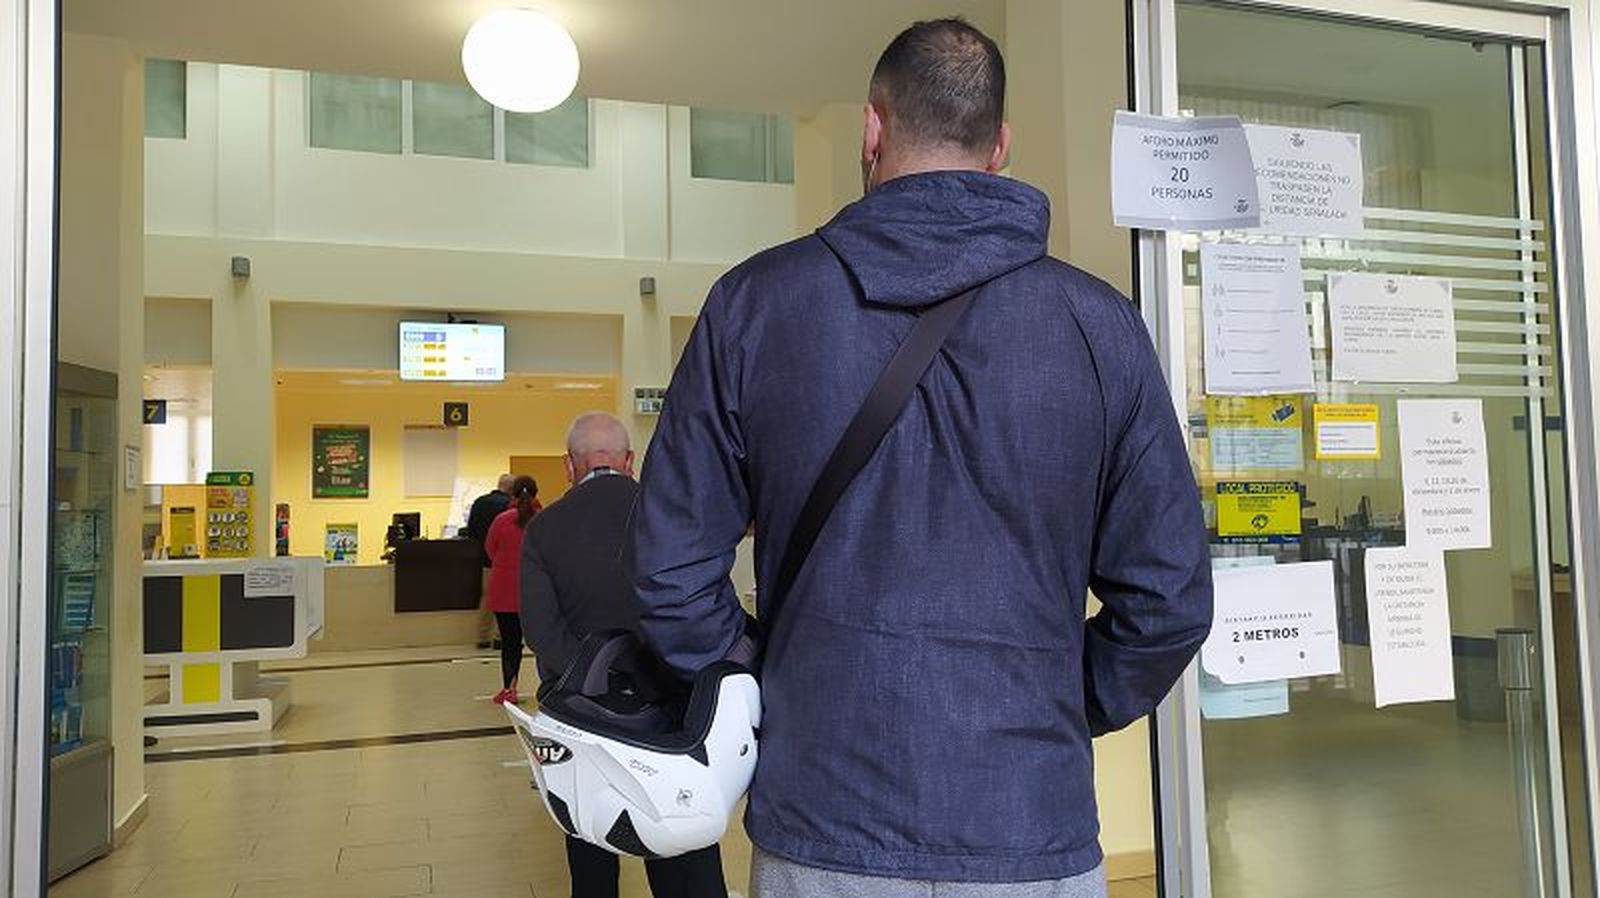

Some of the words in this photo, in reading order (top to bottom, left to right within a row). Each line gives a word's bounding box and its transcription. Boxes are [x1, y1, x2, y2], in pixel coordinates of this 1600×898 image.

[1141, 135, 1174, 147] AFORO
[1153, 149, 1209, 161] PERMITIDO
[1170, 166, 1189, 183] 20
[1151, 186, 1213, 200] PERSONAS
[146, 404, 158, 420] 7
[450, 408, 462, 422] 6
[1231, 631, 1241, 643] 2
[1243, 627, 1300, 641] METROS
